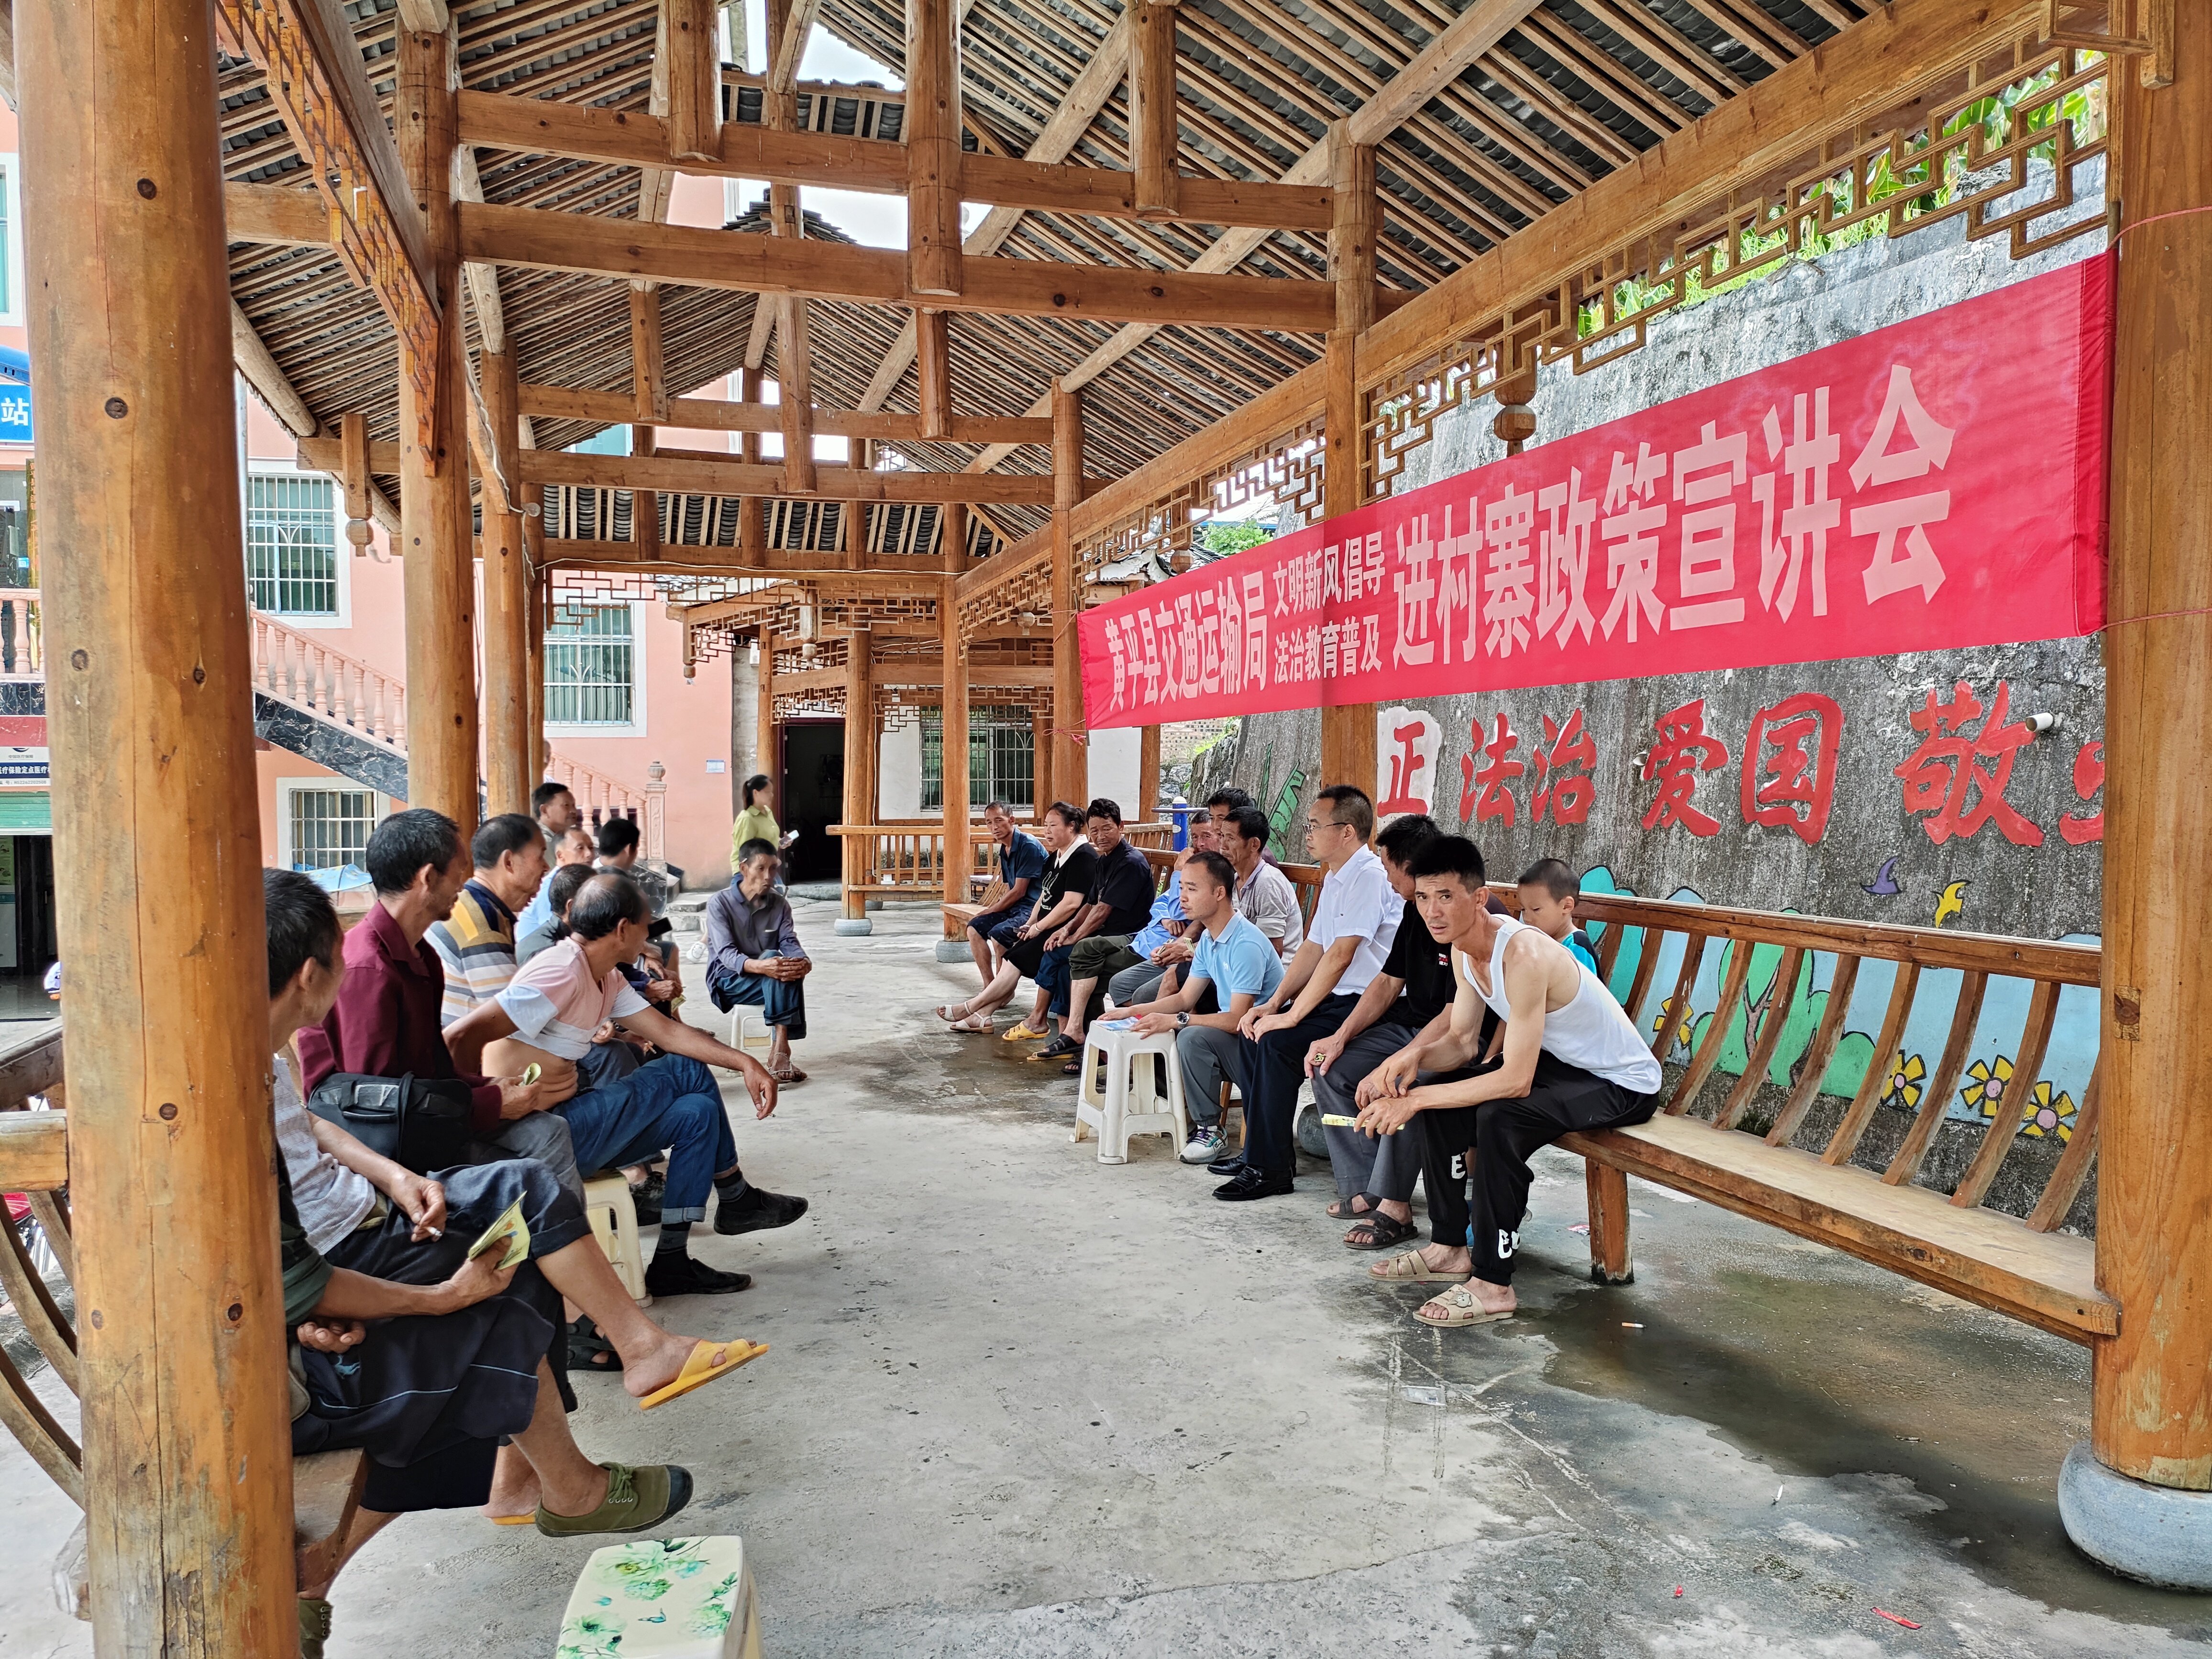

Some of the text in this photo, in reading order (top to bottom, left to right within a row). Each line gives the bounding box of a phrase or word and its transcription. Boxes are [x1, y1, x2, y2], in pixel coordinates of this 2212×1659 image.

[1, 397, 29, 426] 站
[1272, 531, 1385, 619] 文明新风倡导
[1393, 365, 1956, 670] 进村寨政策宣讲会
[1105, 569, 1267, 712] 黄平县交通运输局
[1274, 615, 1382, 685] 法治教育普及
[1460, 708, 1596, 828] 法治
[1642, 692, 1844, 845] 爱国
